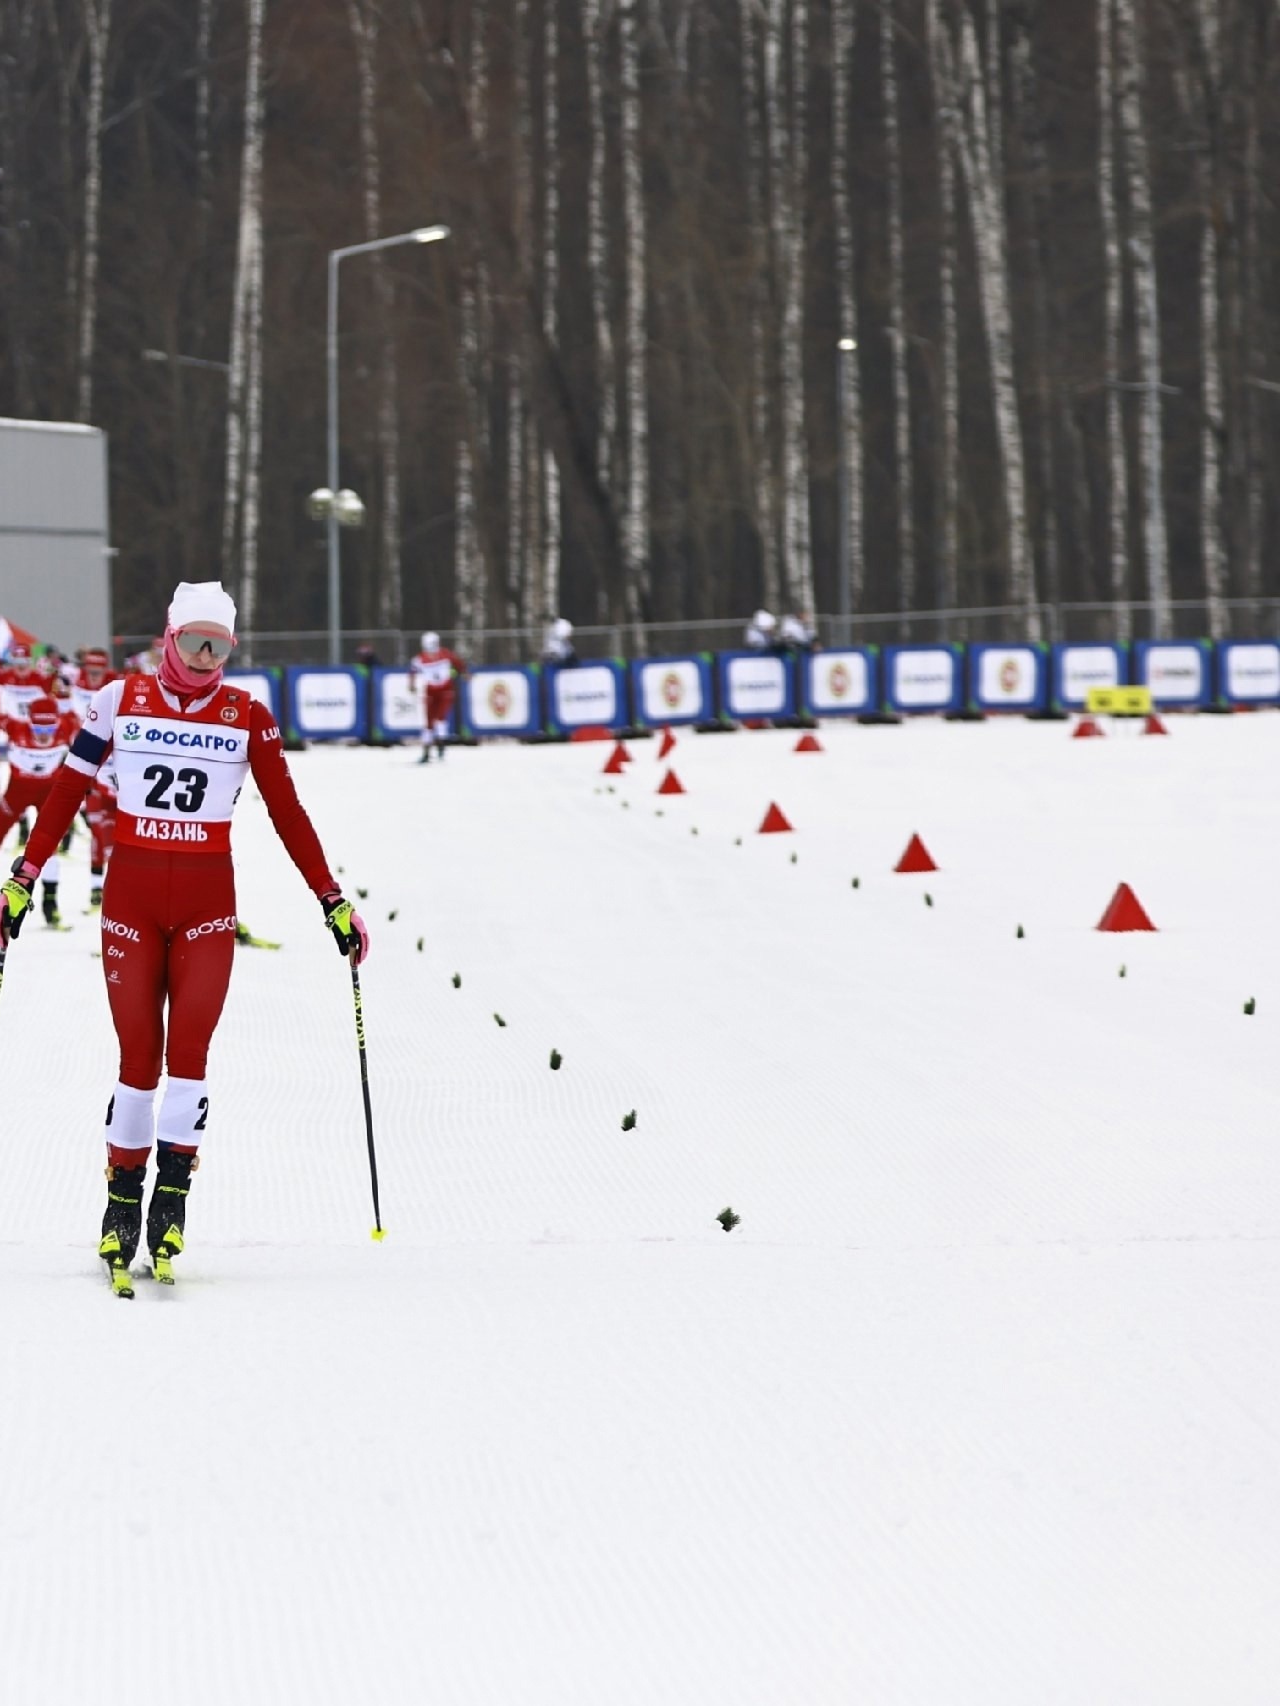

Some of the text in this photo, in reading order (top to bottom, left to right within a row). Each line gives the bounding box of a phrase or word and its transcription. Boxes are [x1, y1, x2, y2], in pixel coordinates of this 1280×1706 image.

[145, 729, 239, 752] ФОСАГРО
[143, 764, 209, 813] 23
[135, 818, 208, 842] КАЗАНЬ
